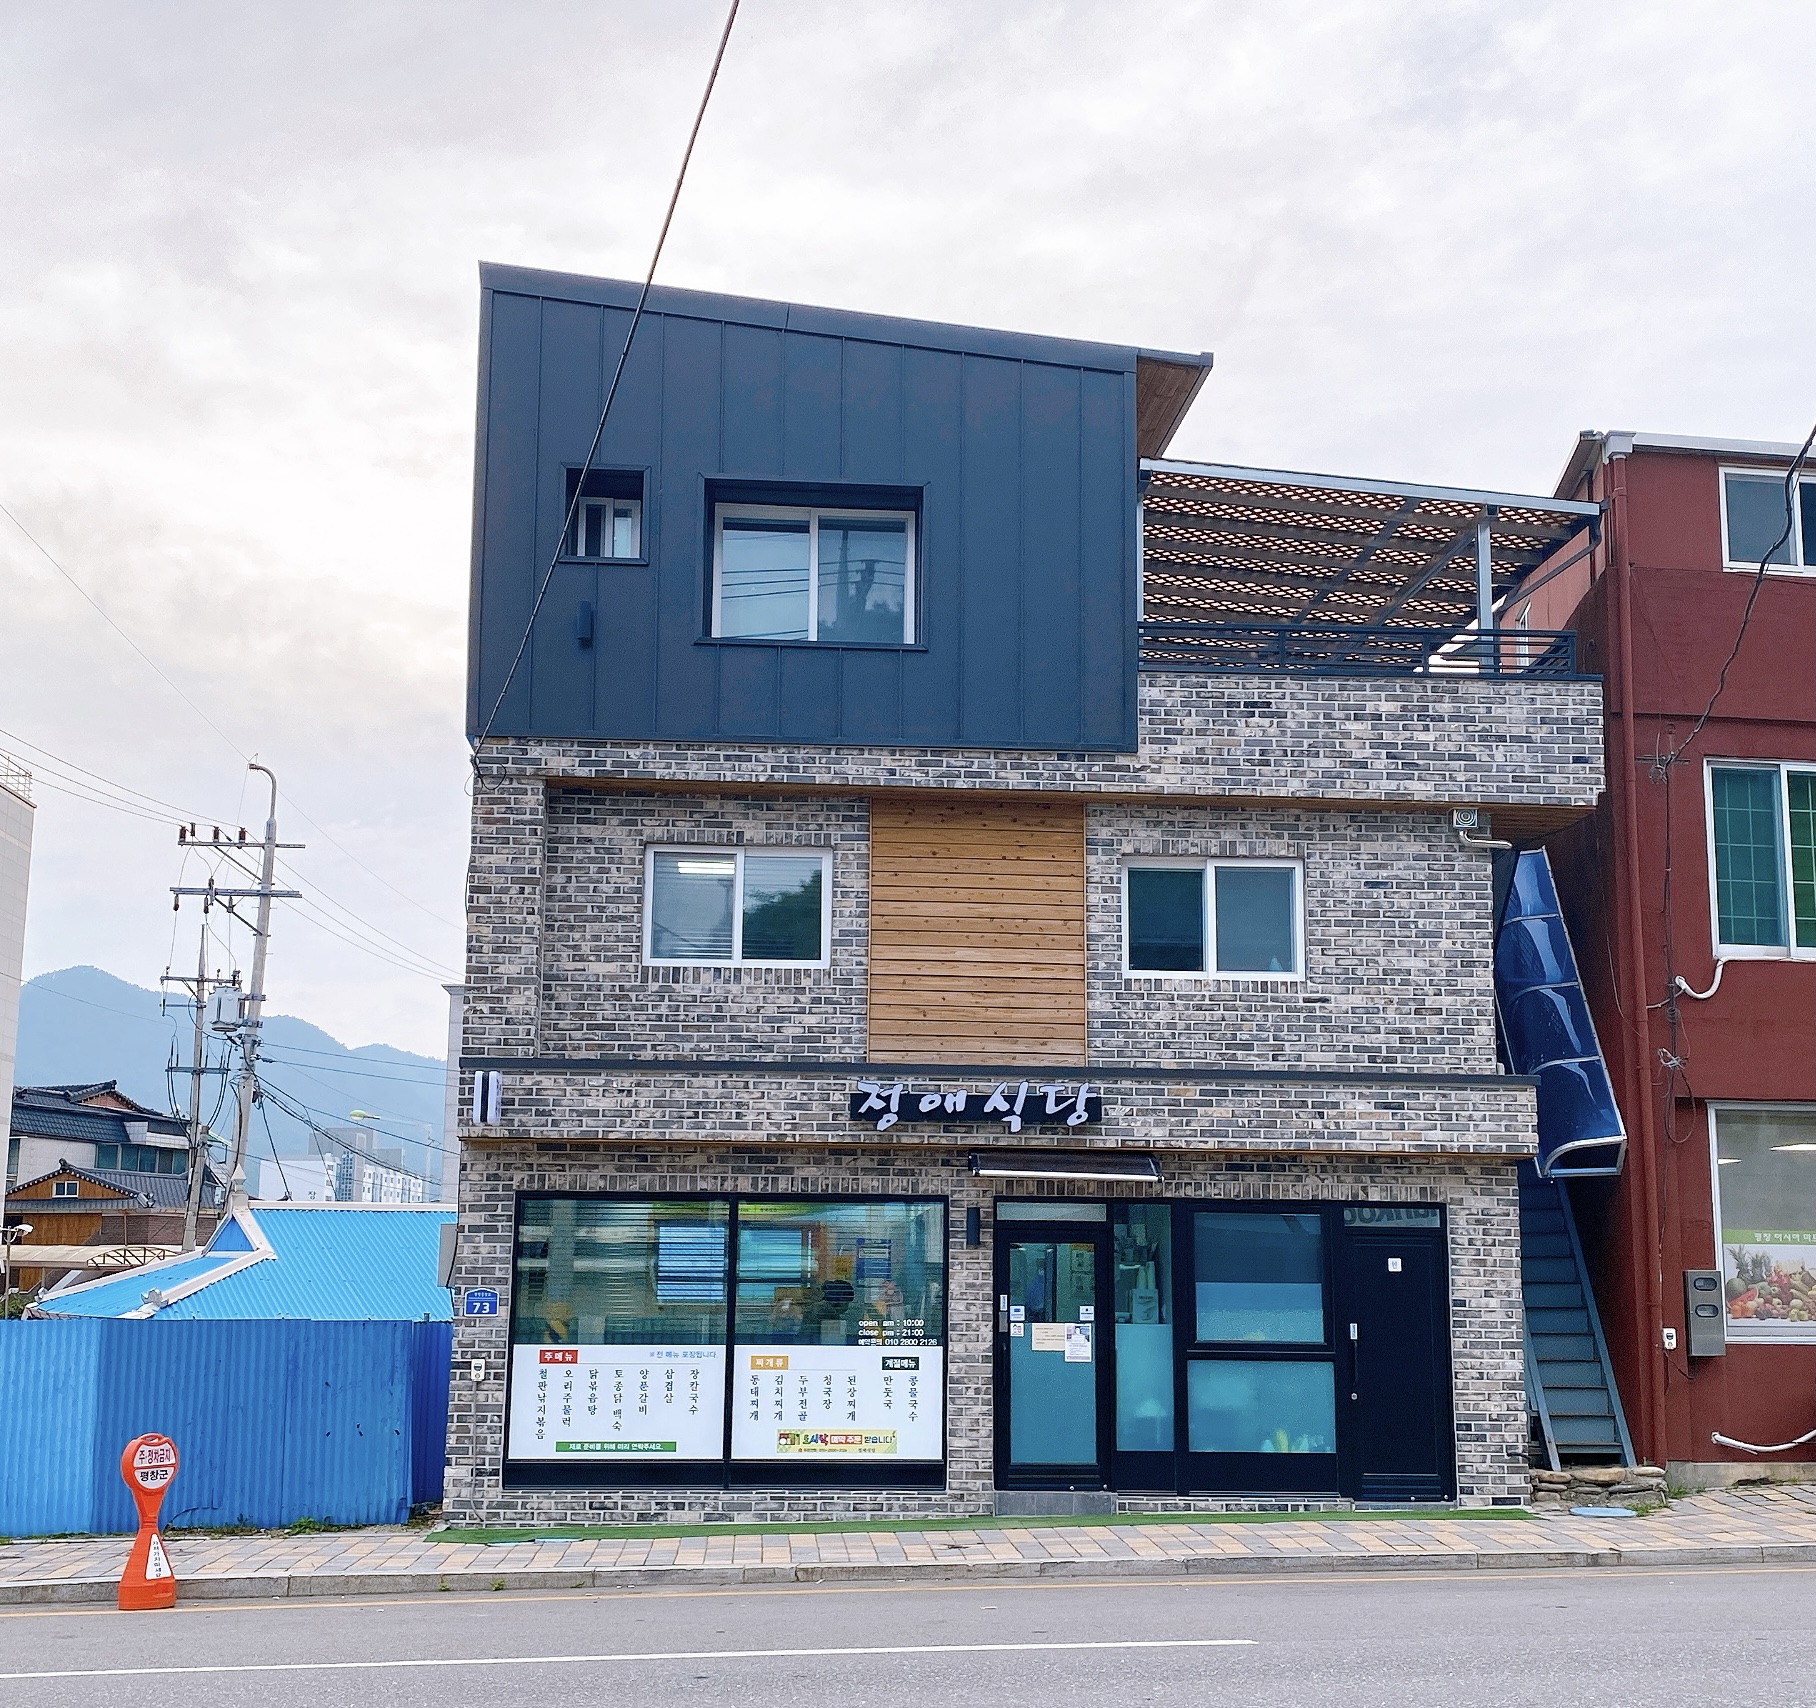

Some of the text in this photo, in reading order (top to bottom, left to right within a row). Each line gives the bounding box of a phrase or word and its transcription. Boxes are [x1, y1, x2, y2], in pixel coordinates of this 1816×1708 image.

[857, 1080, 1098, 1132] 정애식당
[472, 1302, 490, 1314] 73
[858, 1320, 879, 1328] open
[902, 1319, 924, 1327] 10:00
[882, 1330, 895, 1338] pm
[885, 1338, 899, 1346] 010
[544, 1352, 573, 1362] 주메뉴
[562, 1369, 574, 1427] 오리주물럭
[587, 1368, 599, 1416] 닭볶음탕
[663, 1368, 675, 1404] 삼겹살
[749, 1374, 760, 1421] 동태찌개
[773, 1374, 784, 1421] 김치찌개
[798, 1374, 808, 1422] 두부전골
[822, 1374, 833, 1410] 청국장
[846, 1374, 857, 1421] 된장찌개
[140, 1469, 168, 1482] 평창군
